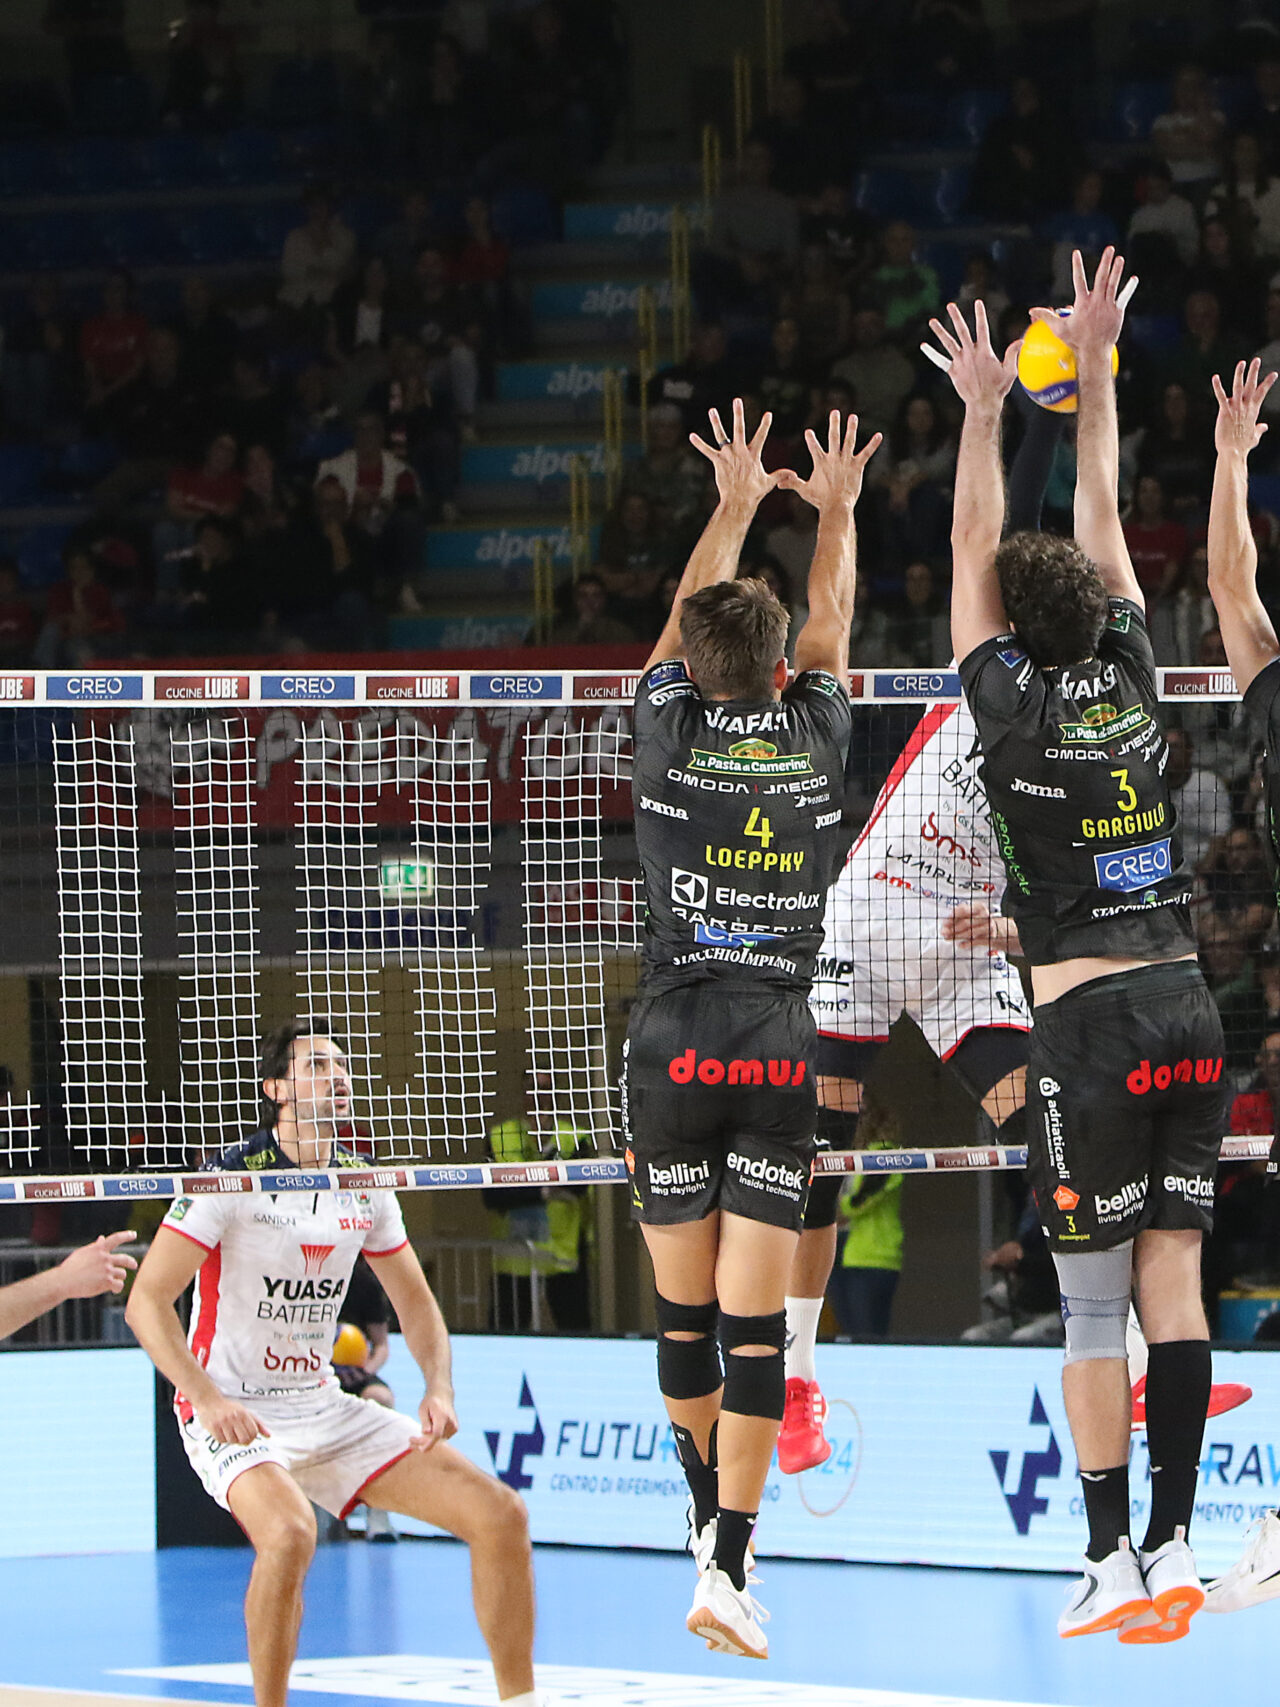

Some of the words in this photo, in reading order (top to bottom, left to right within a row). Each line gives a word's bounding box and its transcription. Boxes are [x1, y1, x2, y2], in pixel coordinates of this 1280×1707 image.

[67, 678, 122, 694] CREO
[166, 687, 202, 698] CUCINE
[205, 678, 238, 698] LUBE
[281, 678, 336, 694] CREO
[377, 687, 413, 698] CUCINE
[415, 677, 449, 698] LUBE
[490, 677, 542, 693] CREO
[584, 687, 619, 698] CUCINE
[621, 677, 640, 698] LU
[893, 676, 943, 691] CREO
[1174, 683, 1207, 694] CUCINE
[707, 757, 742, 771] Pasta
[751, 759, 807, 773] Camerino
[667, 768, 750, 794] OMODA
[763, 774, 828, 795] JAECOO
[1110, 768, 1138, 812] 3
[743, 806, 774, 848] 4
[1081, 802, 1165, 839] GARGIULO
[705, 844, 804, 873] LOEPPKY
[1104, 847, 1168, 880] CREO
[715, 886, 821, 911] Electrolux
[668, 1048, 806, 1087] domus
[1048, 1099, 1071, 1180] adriaticaoli
[822, 1157, 846, 1171] LUBE
[876, 1154, 912, 1167] CREO
[967, 1151, 990, 1166] LUBE
[430, 1169, 467, 1182] CREO
[526, 1167, 550, 1182] LUBE
[581, 1164, 618, 1177] CREO
[648, 1160, 710, 1186] bellini
[726, 1151, 805, 1190] endotek
[60, 1181, 86, 1197] LUBE
[119, 1179, 158, 1192] CREO
[219, 1177, 243, 1193] LUBE
[276, 1175, 314, 1188] CREO
[373, 1173, 398, 1188] LUBE
[1094, 1173, 1149, 1215] bellini
[1065, 1215, 1076, 1233] 3
[263, 1275, 345, 1300] YUASA
[815, 1438, 854, 1475] 24
[550, 1475, 599, 1493] CENTRO
[601, 1478, 612, 1494] DI
